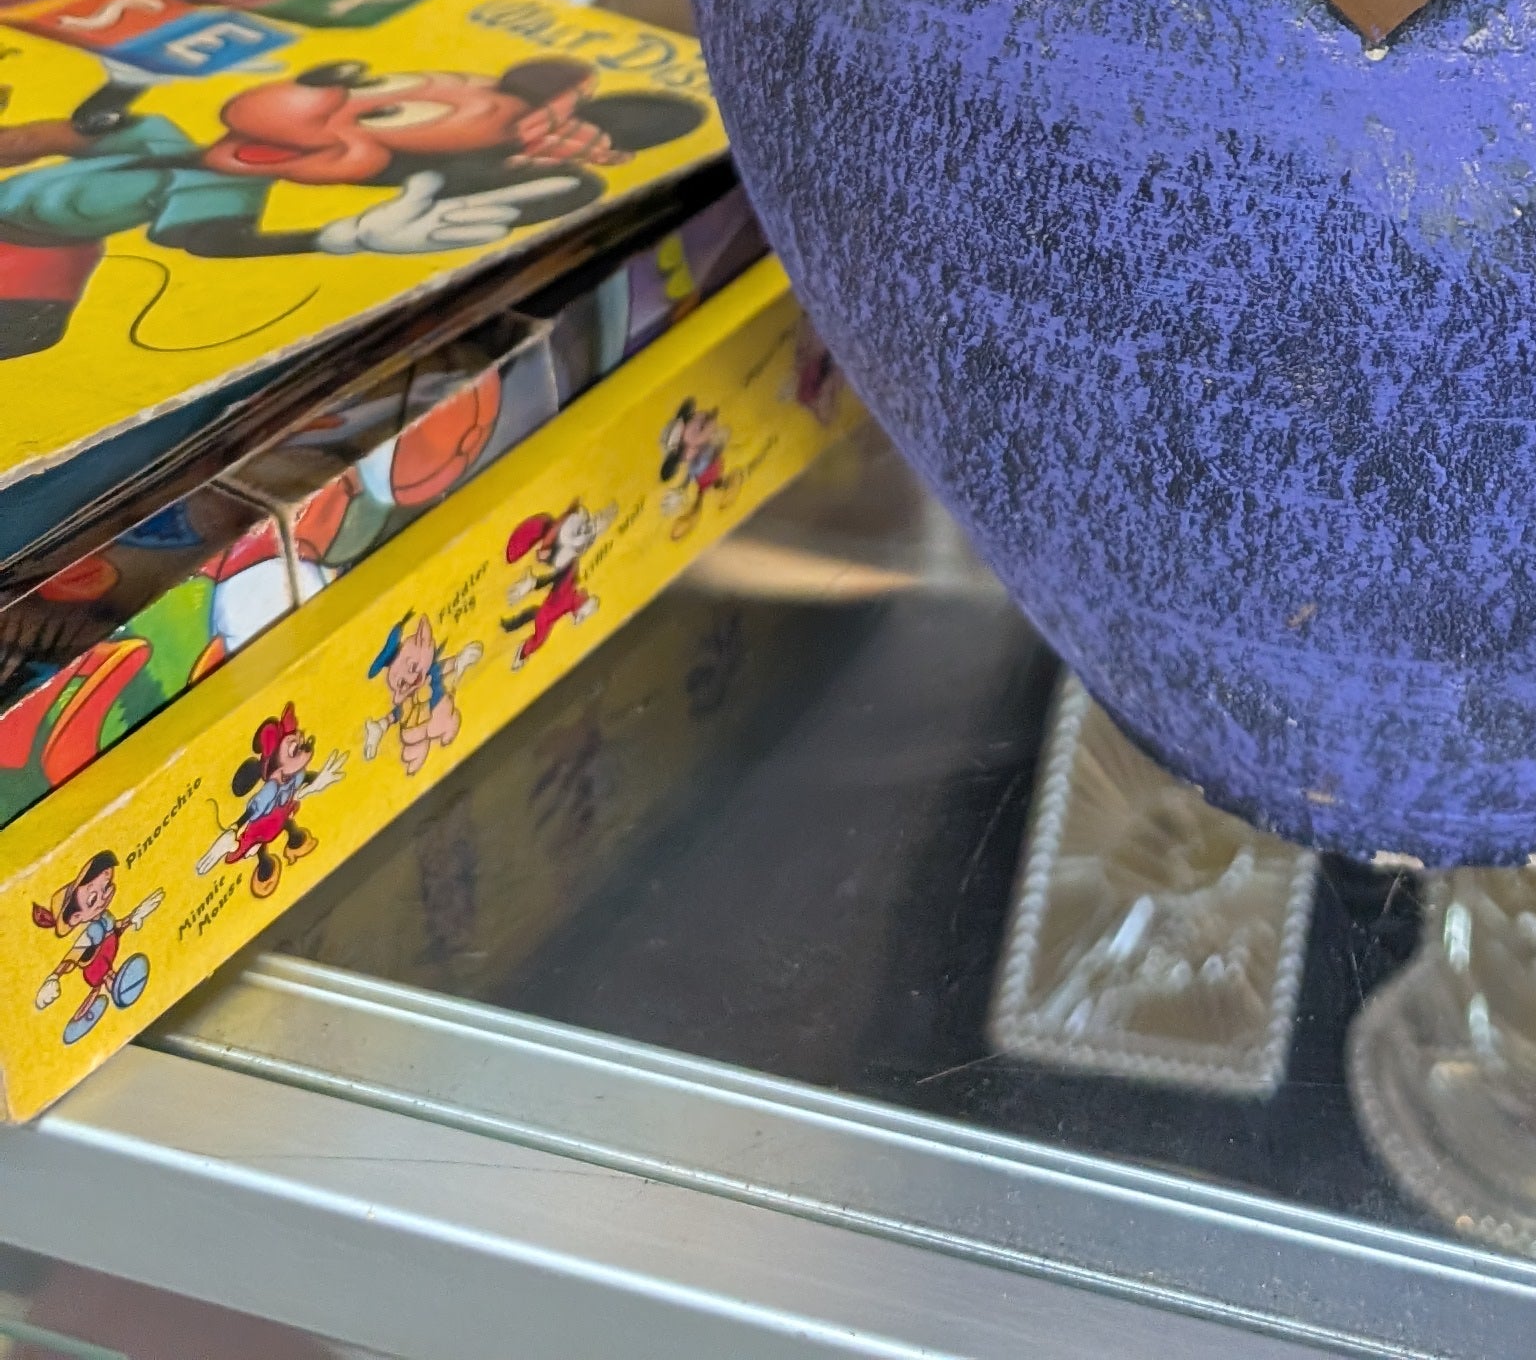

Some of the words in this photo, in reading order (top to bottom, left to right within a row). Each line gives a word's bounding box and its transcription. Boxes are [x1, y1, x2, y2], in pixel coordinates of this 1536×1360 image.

[125, 777, 202, 870] Pinocchio
[179, 876, 225, 941] Minnie
[198, 873, 243, 936] Mouse
